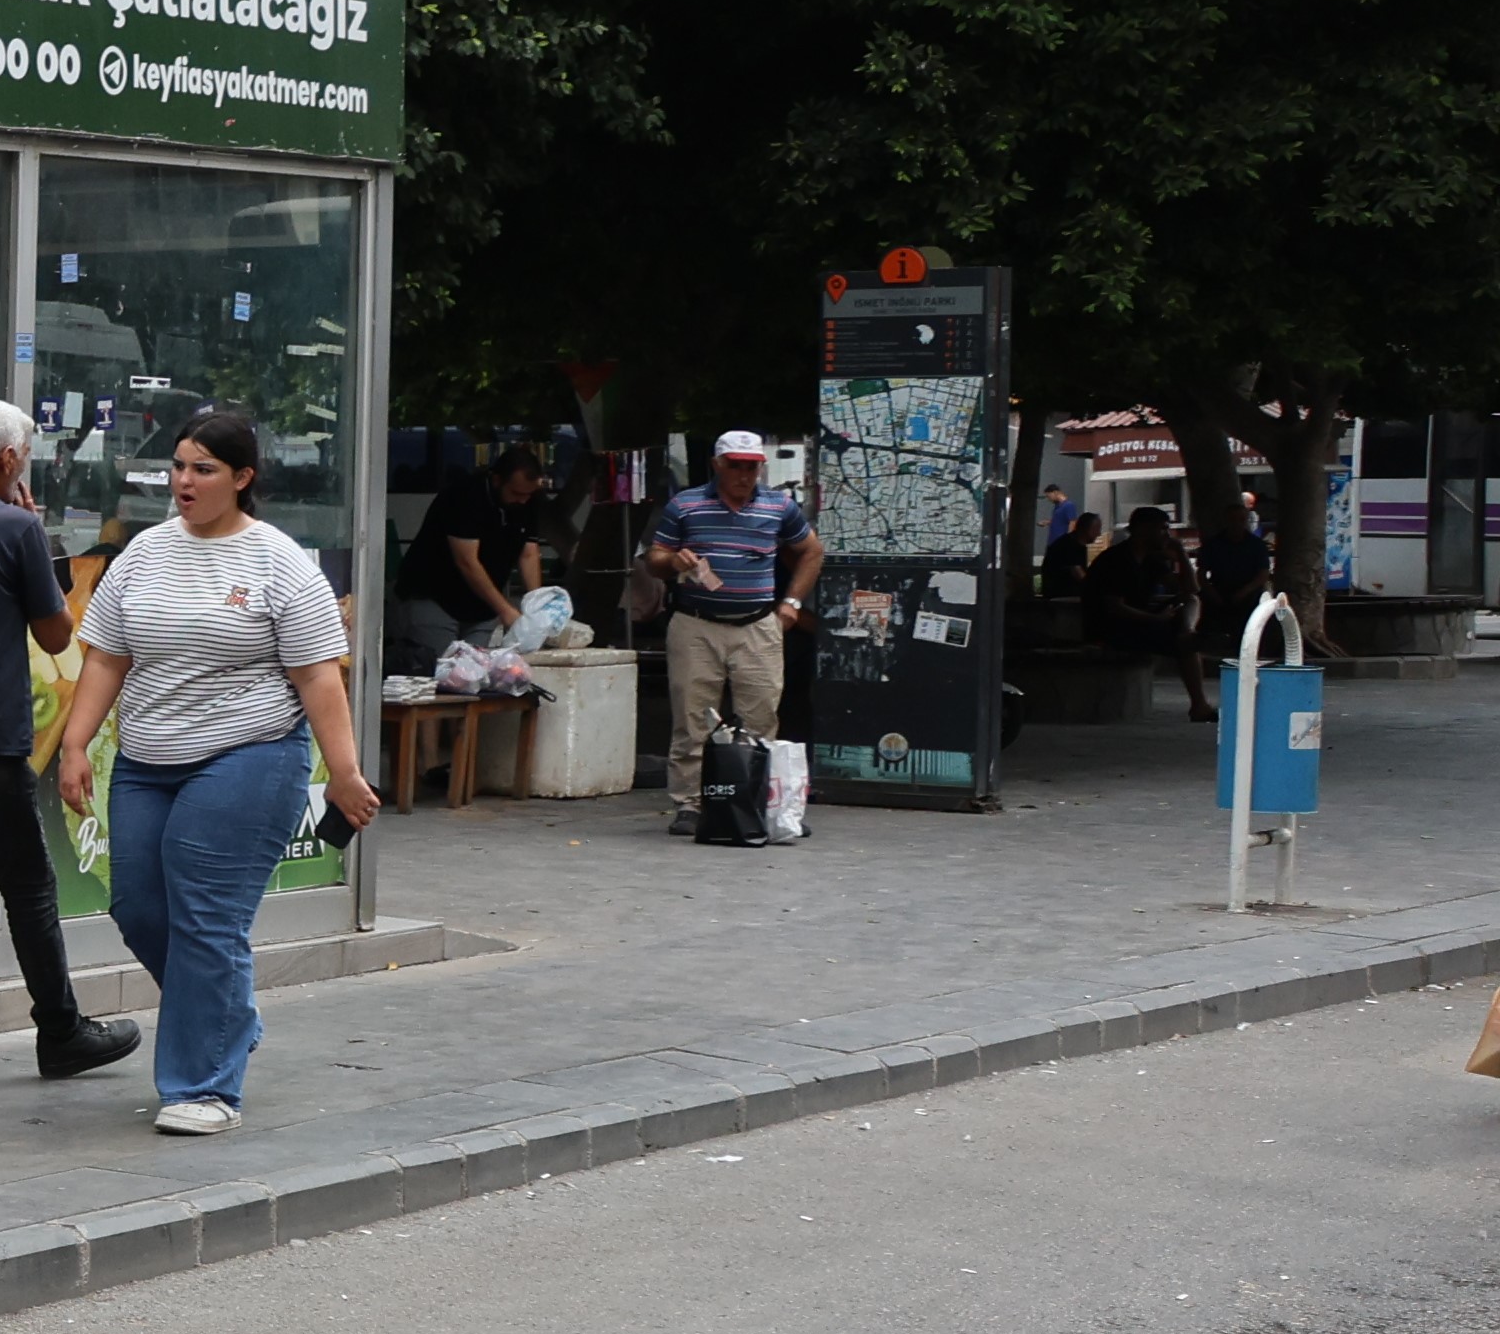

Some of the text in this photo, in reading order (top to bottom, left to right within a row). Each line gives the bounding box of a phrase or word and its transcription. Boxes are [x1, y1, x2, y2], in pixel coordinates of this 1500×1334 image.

[37, 42, 81, 85] 00
[132, 53, 368, 113] keyfiasyakatmer.com
[1098, 440, 1145, 456] DÖRTYOL
[703, 784, 736, 796] LORIS
